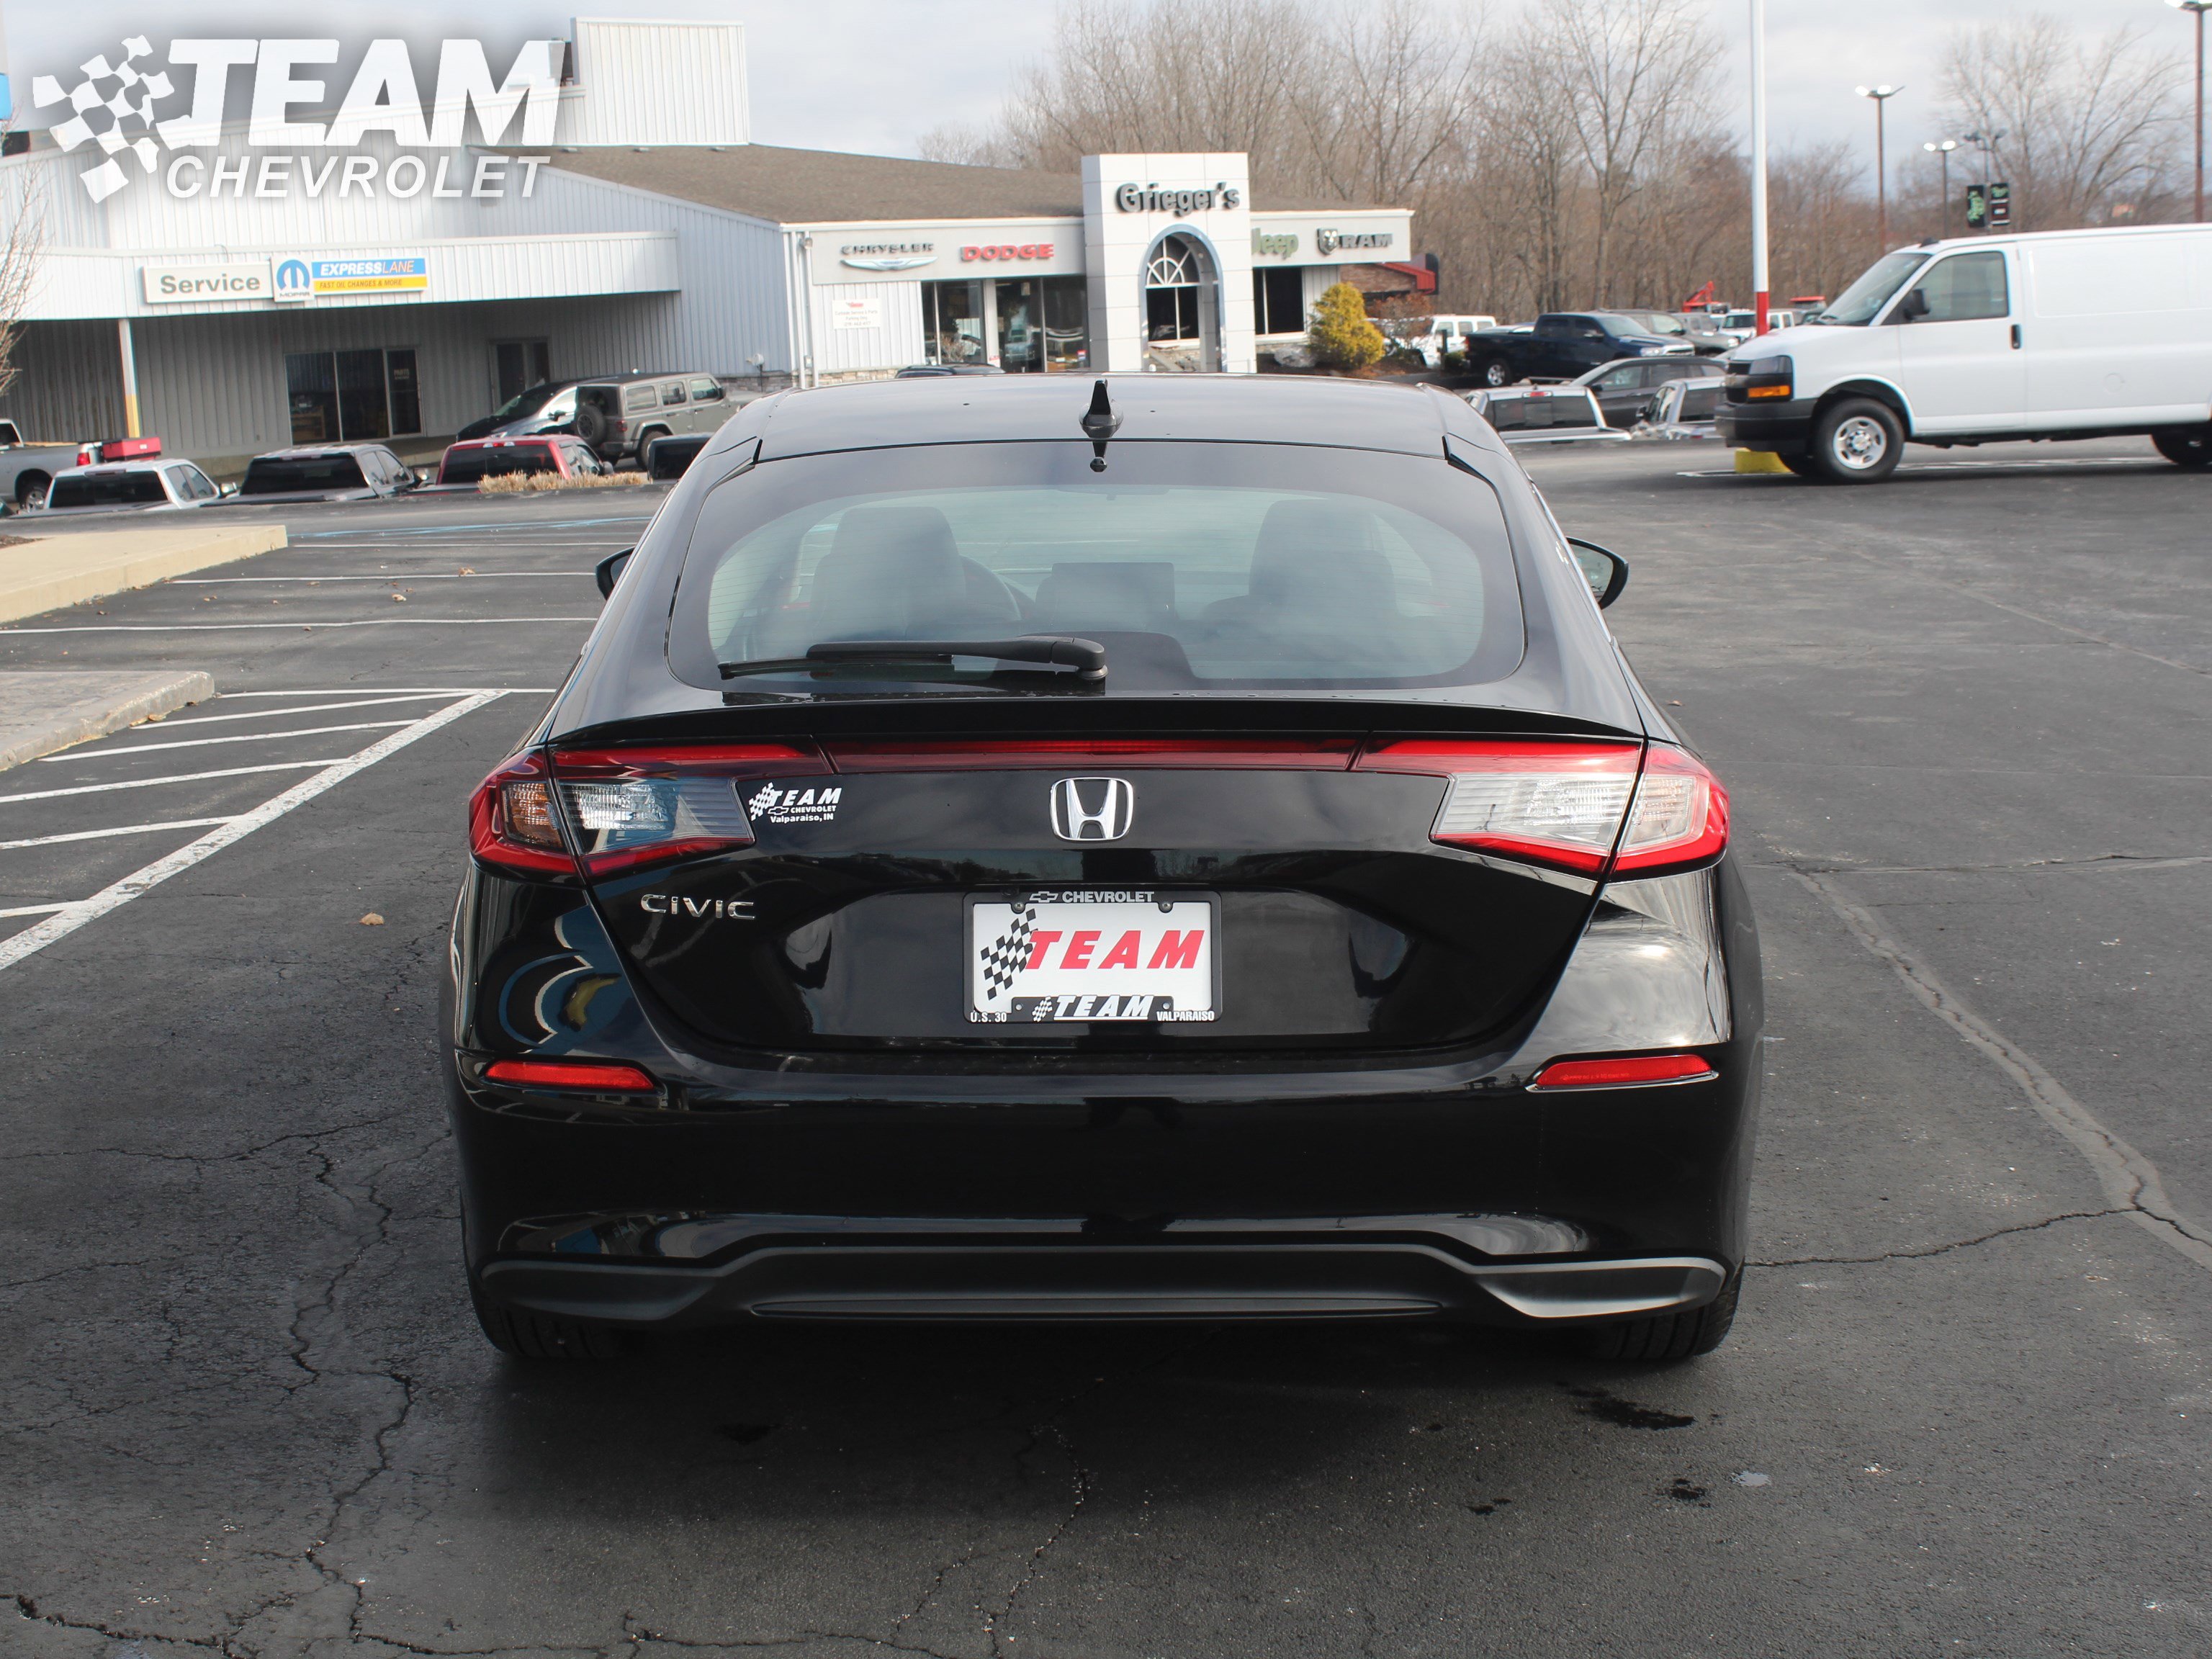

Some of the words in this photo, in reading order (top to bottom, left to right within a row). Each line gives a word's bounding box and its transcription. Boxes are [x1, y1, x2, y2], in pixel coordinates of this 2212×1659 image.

[1115, 181, 1240, 217] Grieger's
[840, 243, 935, 255] CHRYSLER
[1339, 233, 1393, 249] RAM
[961, 244, 1055, 261] DODGE
[320, 260, 415, 276] EXPRESSLANE
[160, 273, 261, 294] Service
[770, 788, 842, 806] TEAM
[770, 814, 822, 824] Valparaiso,
[1061, 891, 1154, 903] CHEVROLET
[641, 894, 755, 920] CIVIC
[1025, 930, 1205, 969] TEAM
[1053, 995, 1154, 1017] TEAM
[970, 1012, 992, 1022] U.S.
[994, 1012, 1007, 1022] 30
[1156, 1010, 1215, 1021] VALPARAISO
